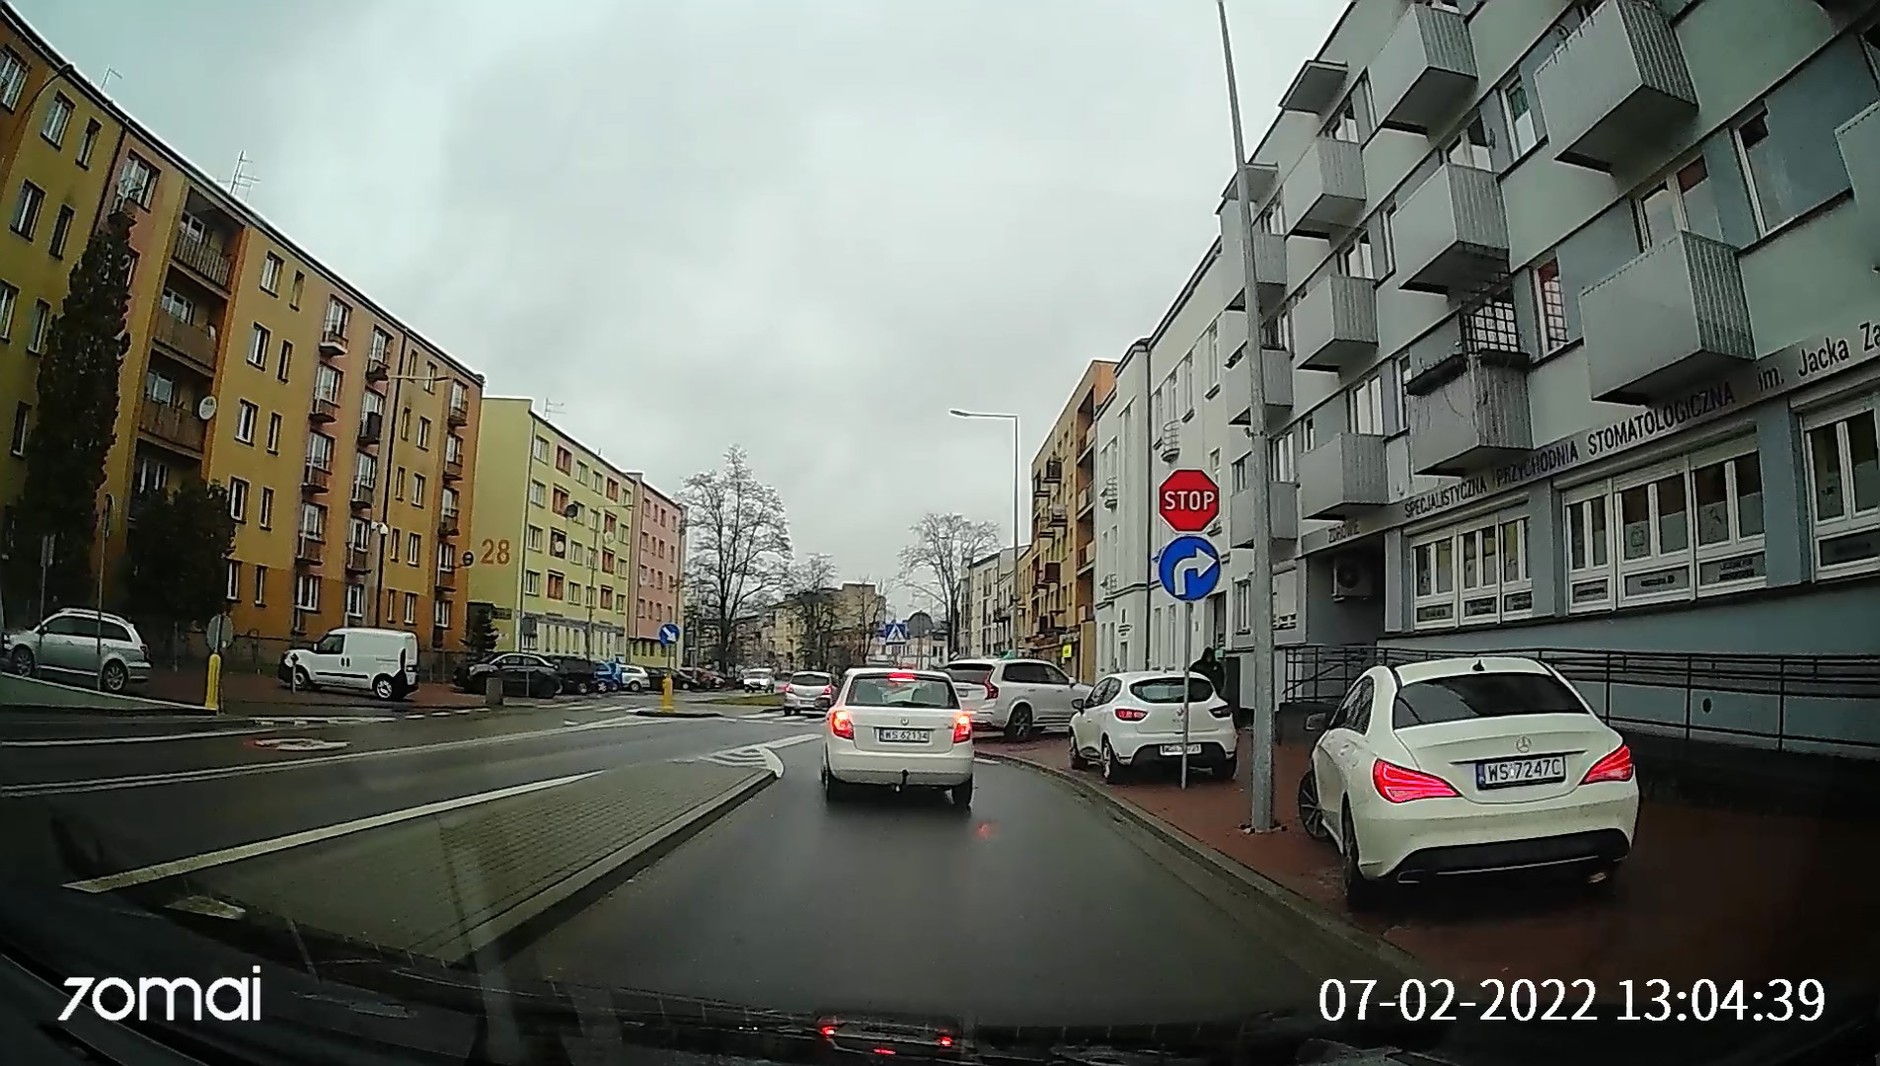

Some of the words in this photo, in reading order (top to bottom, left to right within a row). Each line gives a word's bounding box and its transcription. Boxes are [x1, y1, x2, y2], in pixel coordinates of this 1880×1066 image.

[1404, 476, 1487, 518] SPECJALISTYCZNA
[1495, 440, 1579, 487] PRZYCHODNIA
[1587, 380, 1736, 457] STOMATOLOGICZNA
[1757, 365, 1785, 391] im.
[1798, 337, 1849, 376] Jacka
[1164, 490, 1215, 511] STOP
[480, 538, 511, 565] 28
[1488, 763, 1509, 782] WS
[1514, 758, 1560, 779] 7247C
